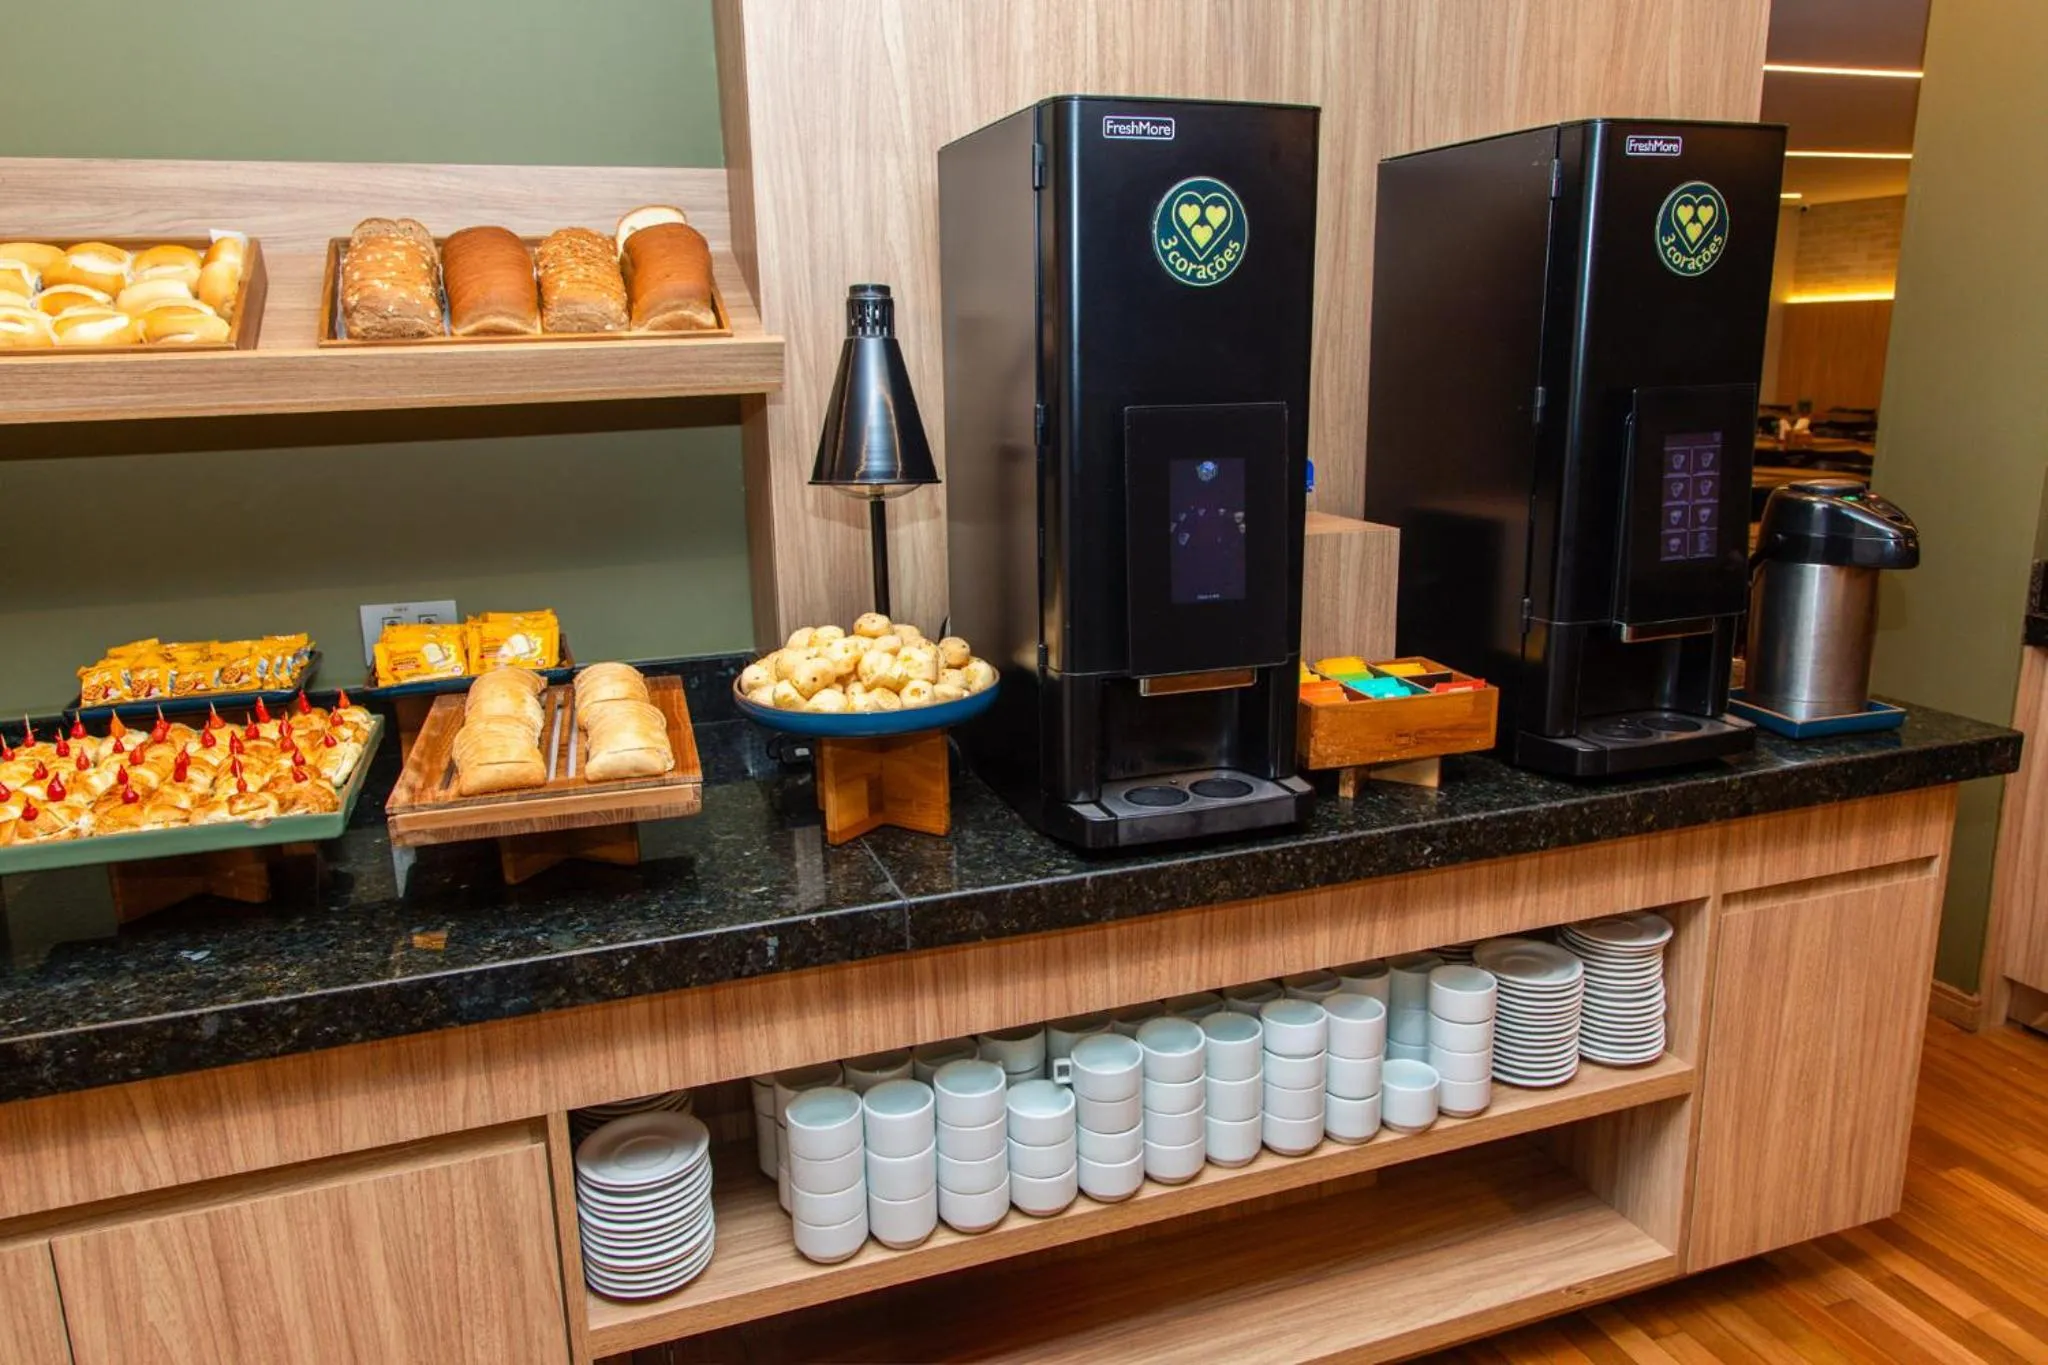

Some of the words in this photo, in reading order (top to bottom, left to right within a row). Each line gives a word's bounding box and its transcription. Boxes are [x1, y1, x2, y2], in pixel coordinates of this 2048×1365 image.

[1106, 120, 1171, 136] FreshMore
[1629, 139, 1679, 152] FreshMore
[1161, 235, 1178, 250] 3
[1662, 233, 1676, 246] 3
[1667, 234, 1723, 270] corações
[1168, 240, 1240, 280] corações
